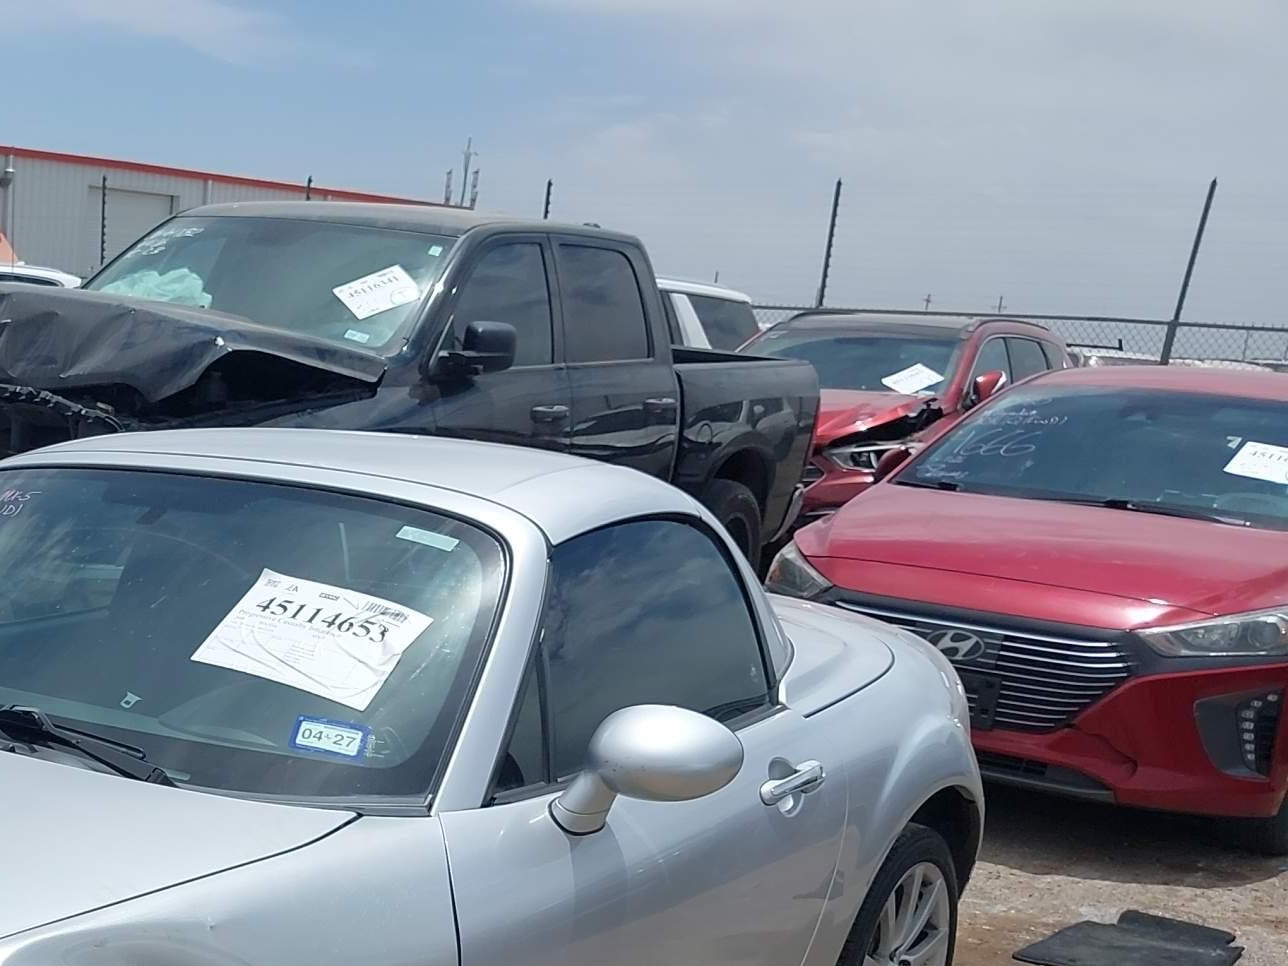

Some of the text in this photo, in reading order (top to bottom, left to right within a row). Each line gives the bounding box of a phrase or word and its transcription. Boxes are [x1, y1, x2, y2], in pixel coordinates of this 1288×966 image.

[255, 596, 390, 643] 45114653
[301, 728, 358, 748] 04 27
